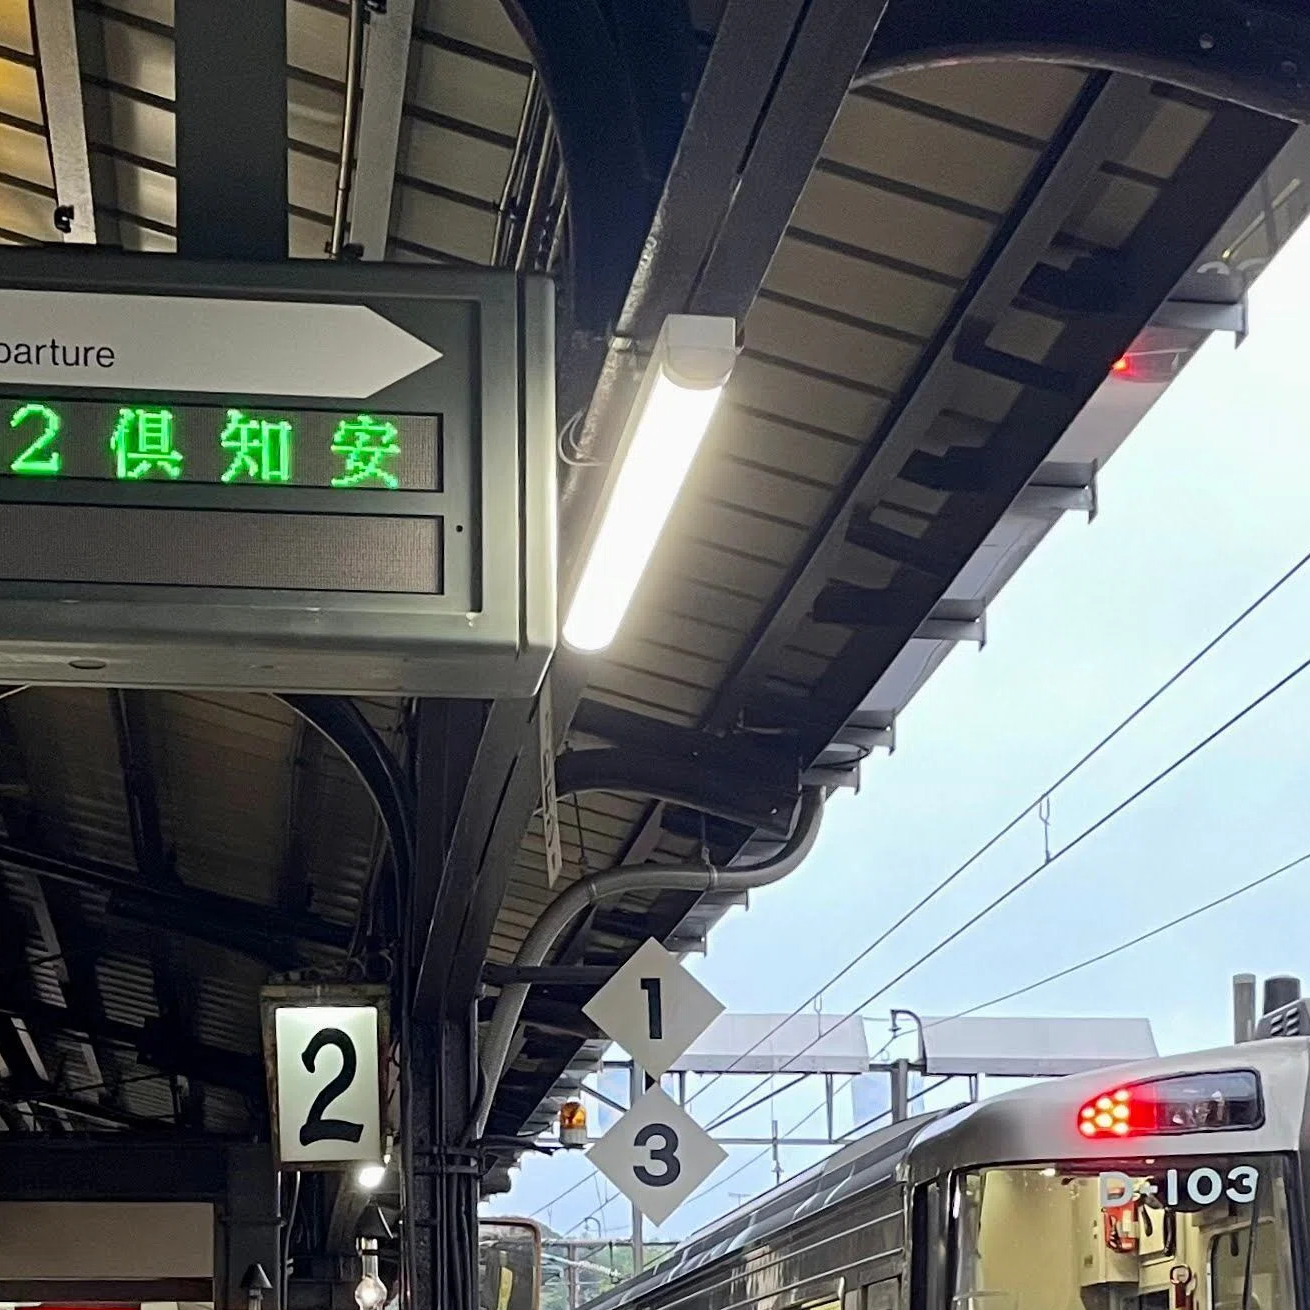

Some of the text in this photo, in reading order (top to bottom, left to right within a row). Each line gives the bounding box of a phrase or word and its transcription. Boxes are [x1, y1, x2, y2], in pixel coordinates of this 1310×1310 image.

[110, 405, 401, 490] 倶知安
[640, 976, 663, 1040] 1
[299, 1027, 364, 1146] 2
[632, 1122, 682, 1186] 3
